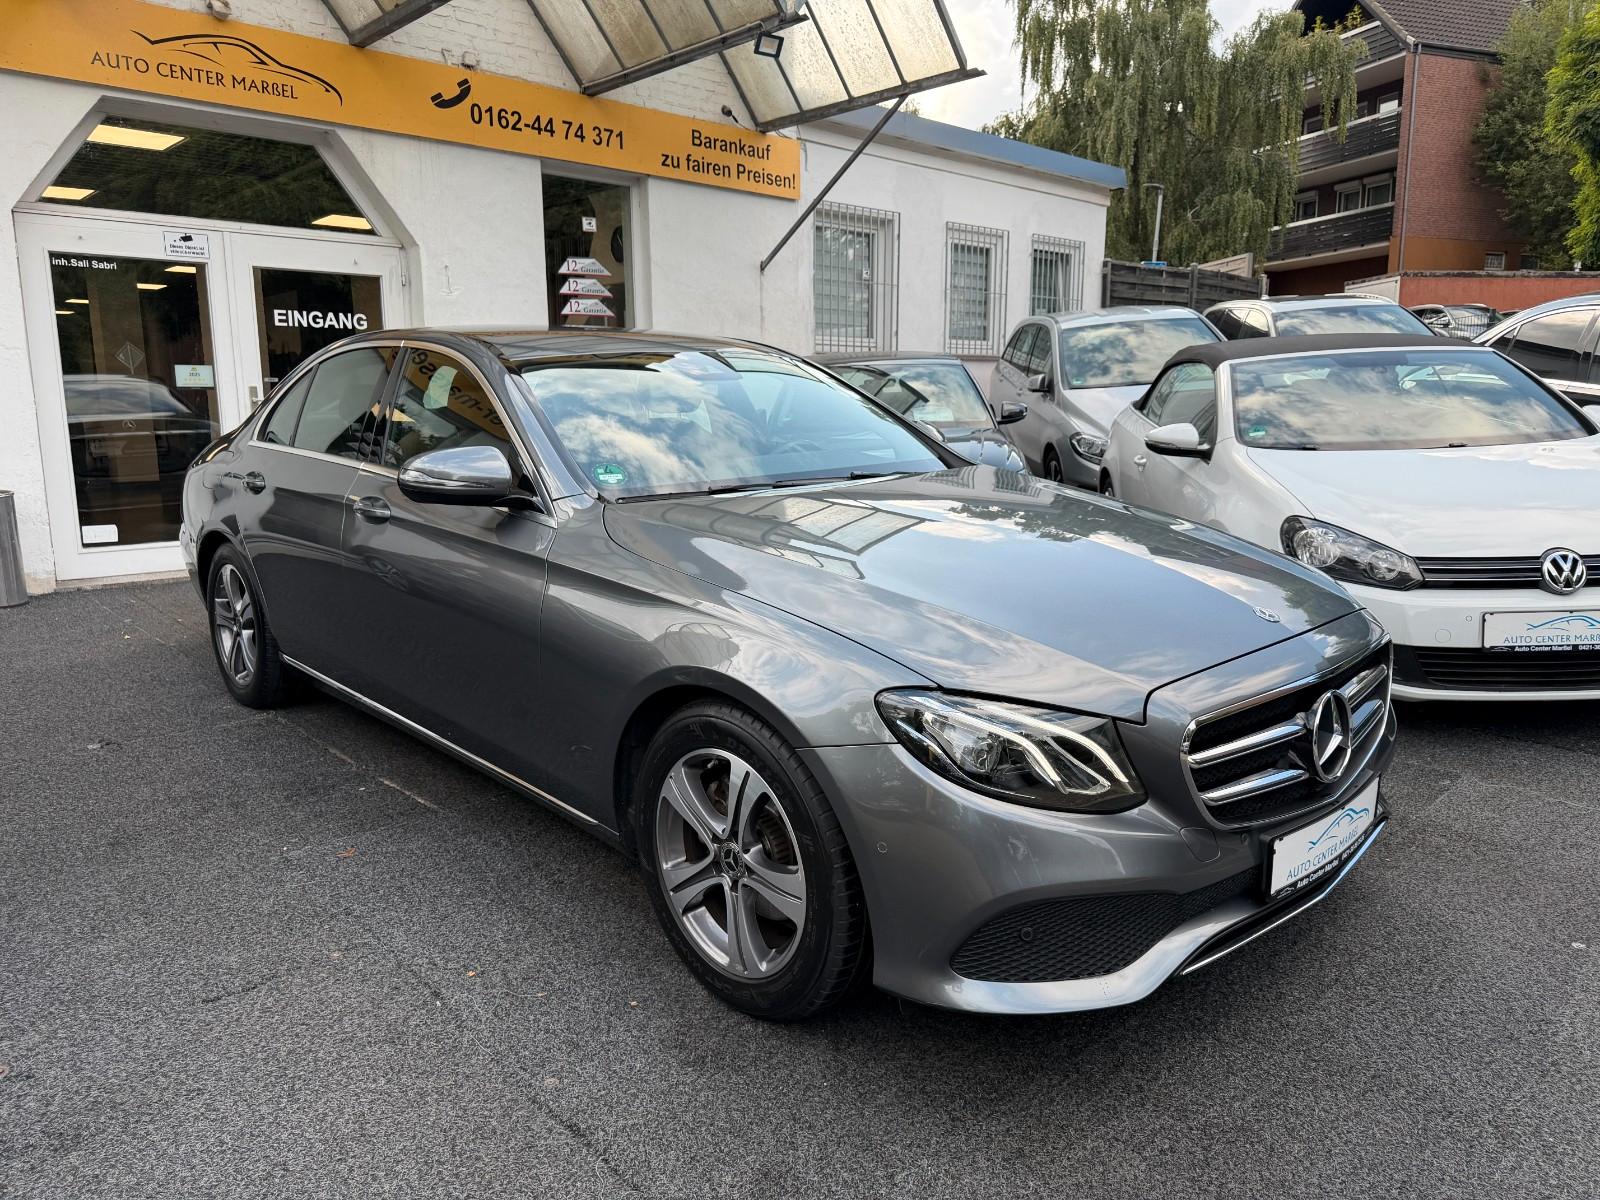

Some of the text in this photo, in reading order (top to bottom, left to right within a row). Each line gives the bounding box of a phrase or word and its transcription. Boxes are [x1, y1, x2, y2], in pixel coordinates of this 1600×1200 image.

[91, 51, 149, 74] AUTO
[156, 62, 226, 87] CENTER
[470, 103, 624, 149] 0162-44 74 371
[691, 128, 771, 160] Barankauf
[661, 153, 796, 190] zu fairen Preisen!
[91, 260, 117, 270] Sabri
[566, 260, 578, 272] 12
[567, 280, 579, 292] 12
[569, 301, 581, 313] 12
[273, 308, 368, 330] EINGANG
[1503, 635, 1532, 644] AUTO
[1535, 634, 1571, 643] CENTER
[1286, 859, 1311, 881] AUTO
[1312, 840, 1339, 866] CENTER
